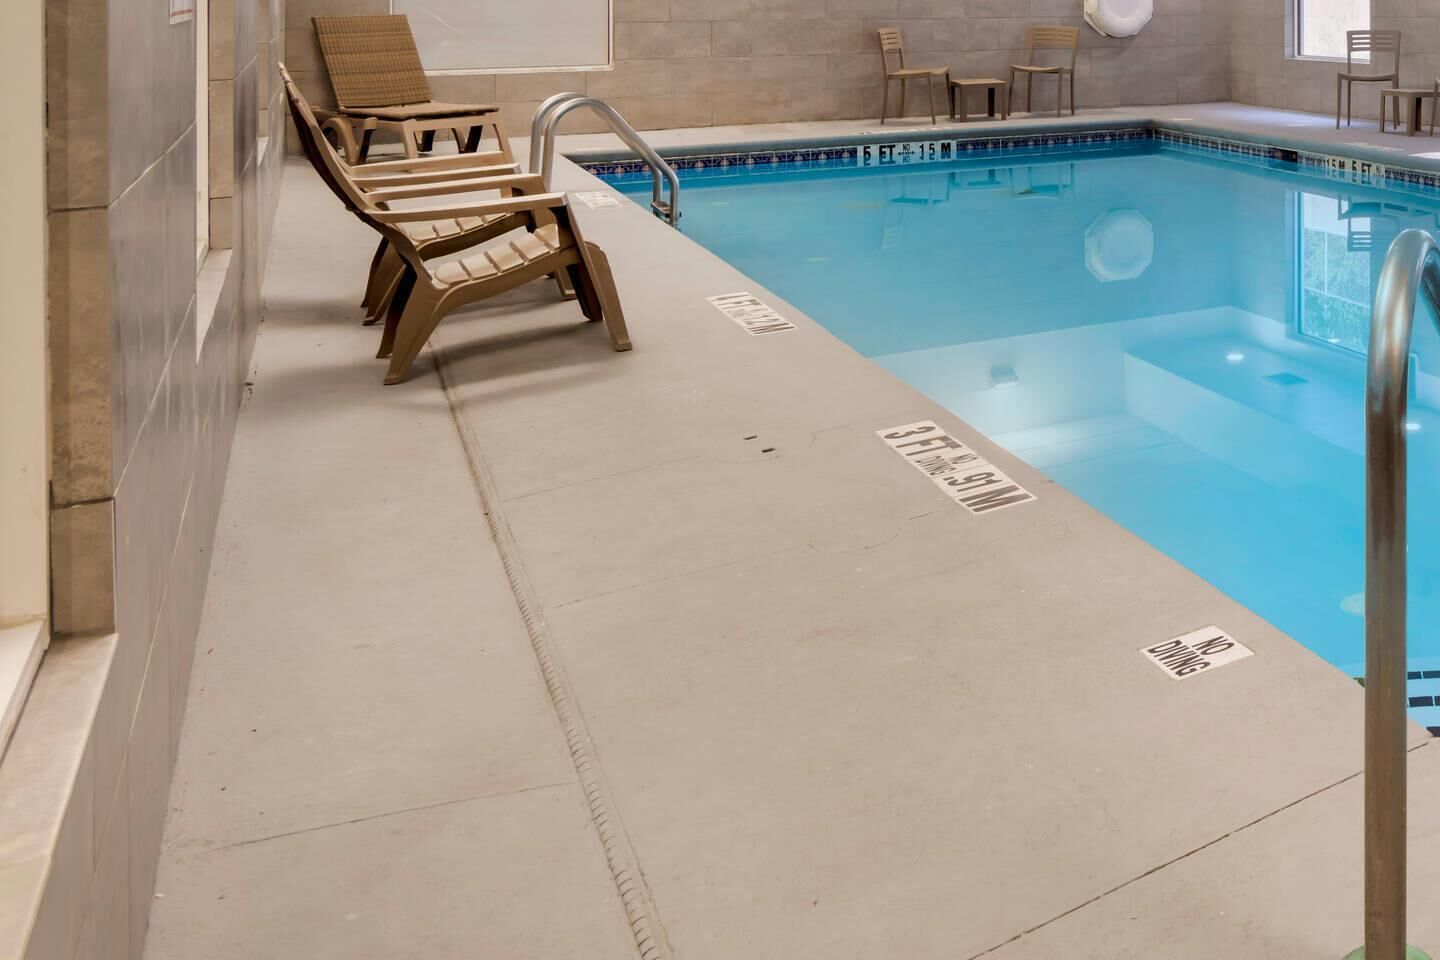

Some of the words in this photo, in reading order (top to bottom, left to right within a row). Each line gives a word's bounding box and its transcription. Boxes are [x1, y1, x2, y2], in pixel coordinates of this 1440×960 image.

[884, 425, 937, 440] 3
[895, 435, 963, 456] FT
[915, 455, 957, 476] DIVING
[951, 452, 978, 464] NO
[958, 484, 1033, 514] M
[1191, 635, 1235, 656] NO
[1147, 639, 1212, 677] DIVING
